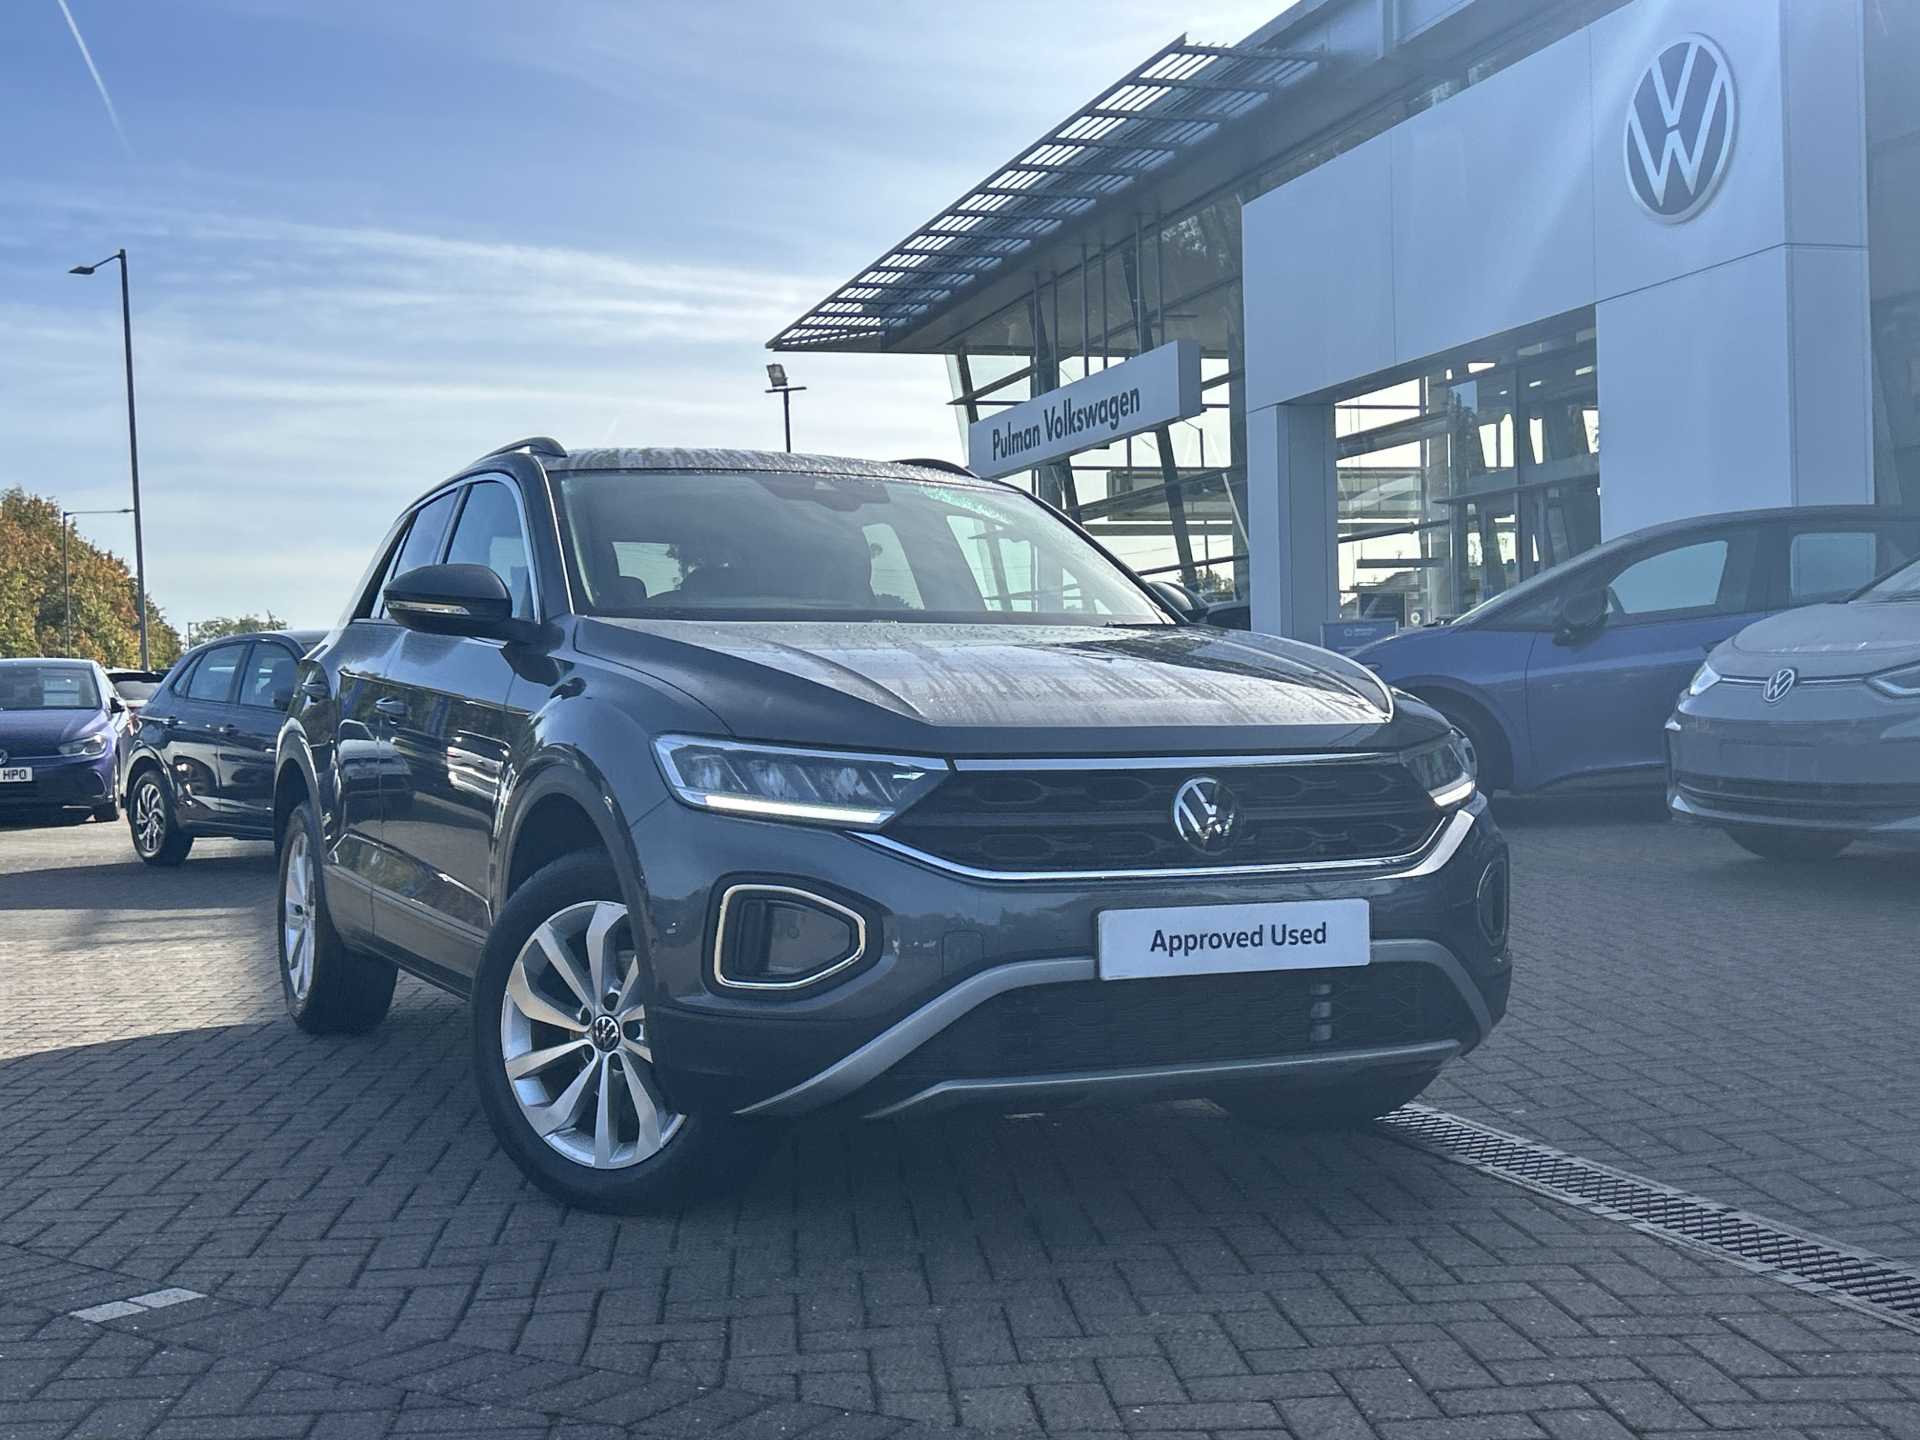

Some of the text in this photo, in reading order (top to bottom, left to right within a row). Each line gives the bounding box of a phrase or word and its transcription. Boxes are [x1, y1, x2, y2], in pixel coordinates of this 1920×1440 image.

[992, 386, 1140, 462] Pulman Volkswagen
[1149, 921, 1328, 957] Approved Used
